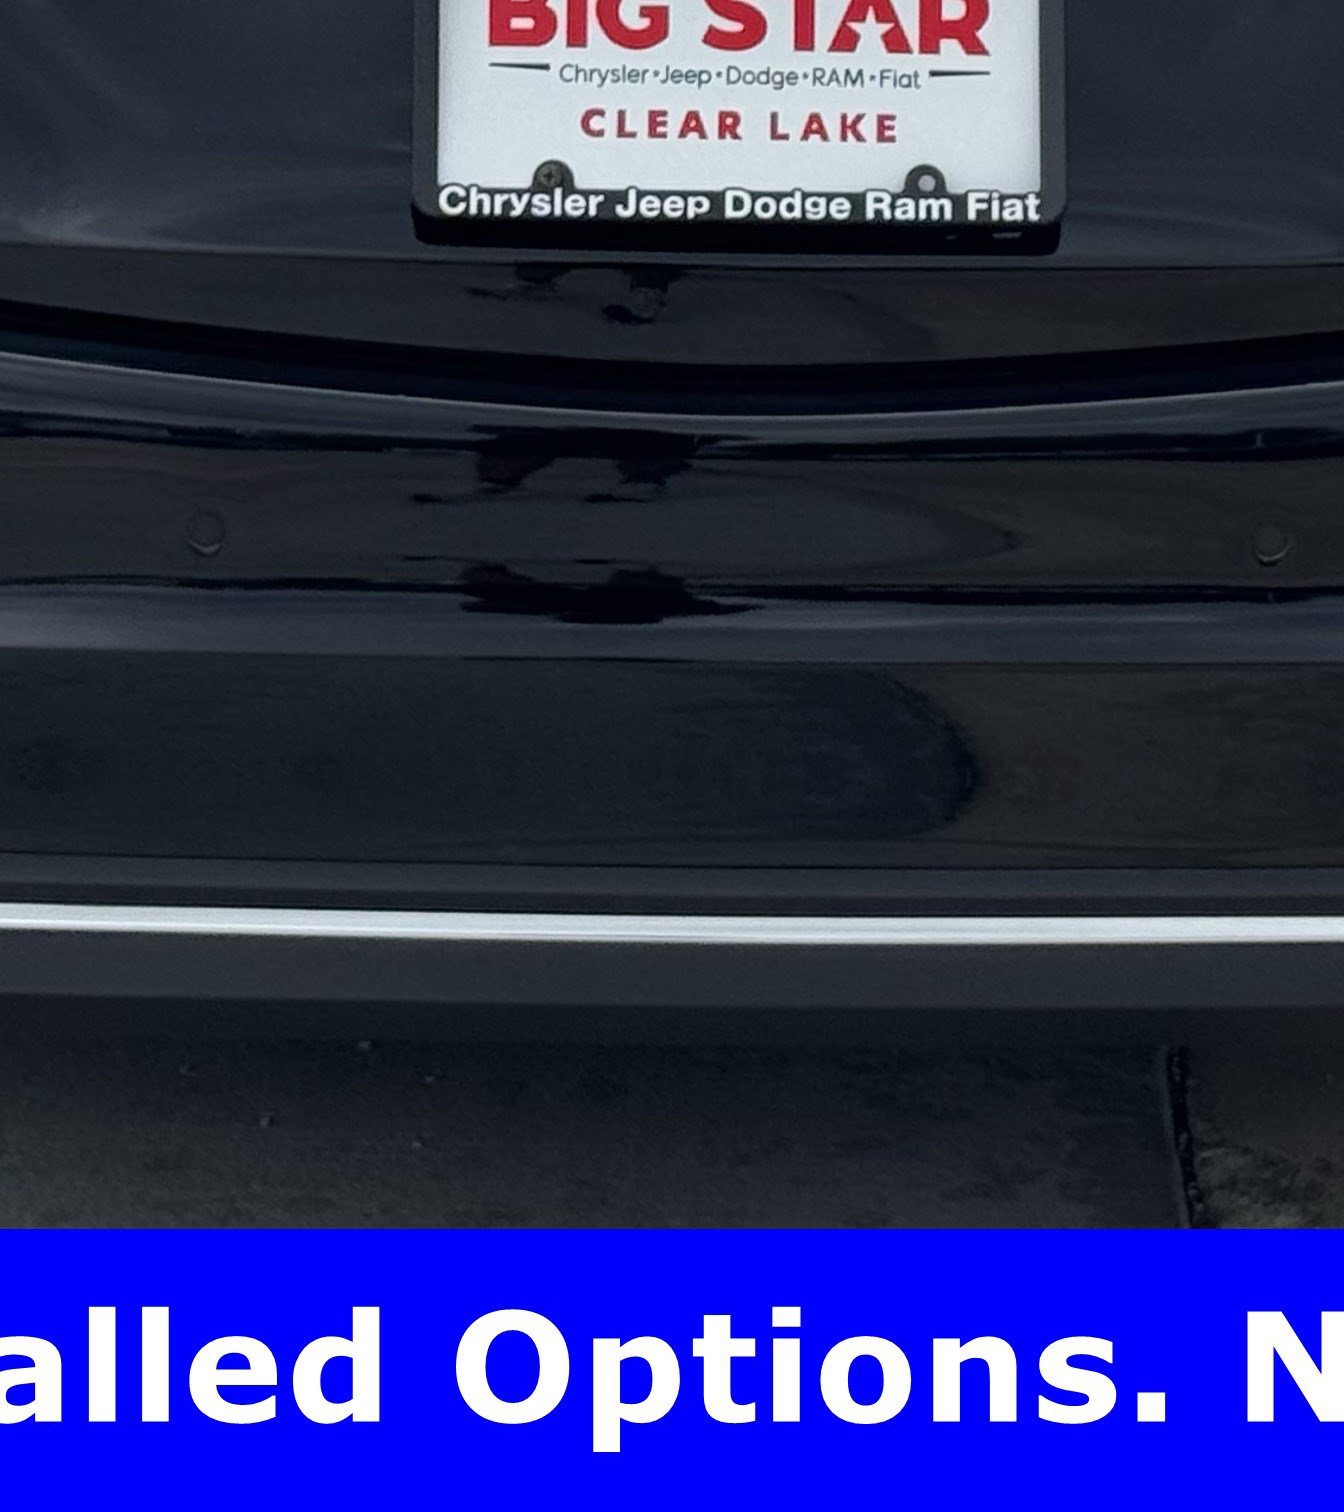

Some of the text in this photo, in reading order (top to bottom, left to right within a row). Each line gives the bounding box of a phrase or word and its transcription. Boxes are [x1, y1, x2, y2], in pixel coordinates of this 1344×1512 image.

[580, 108, 898, 143] CLEAR LAKE
[438, 185, 1040, 222] Chrysler Jeep Dodge Ram Fiat
